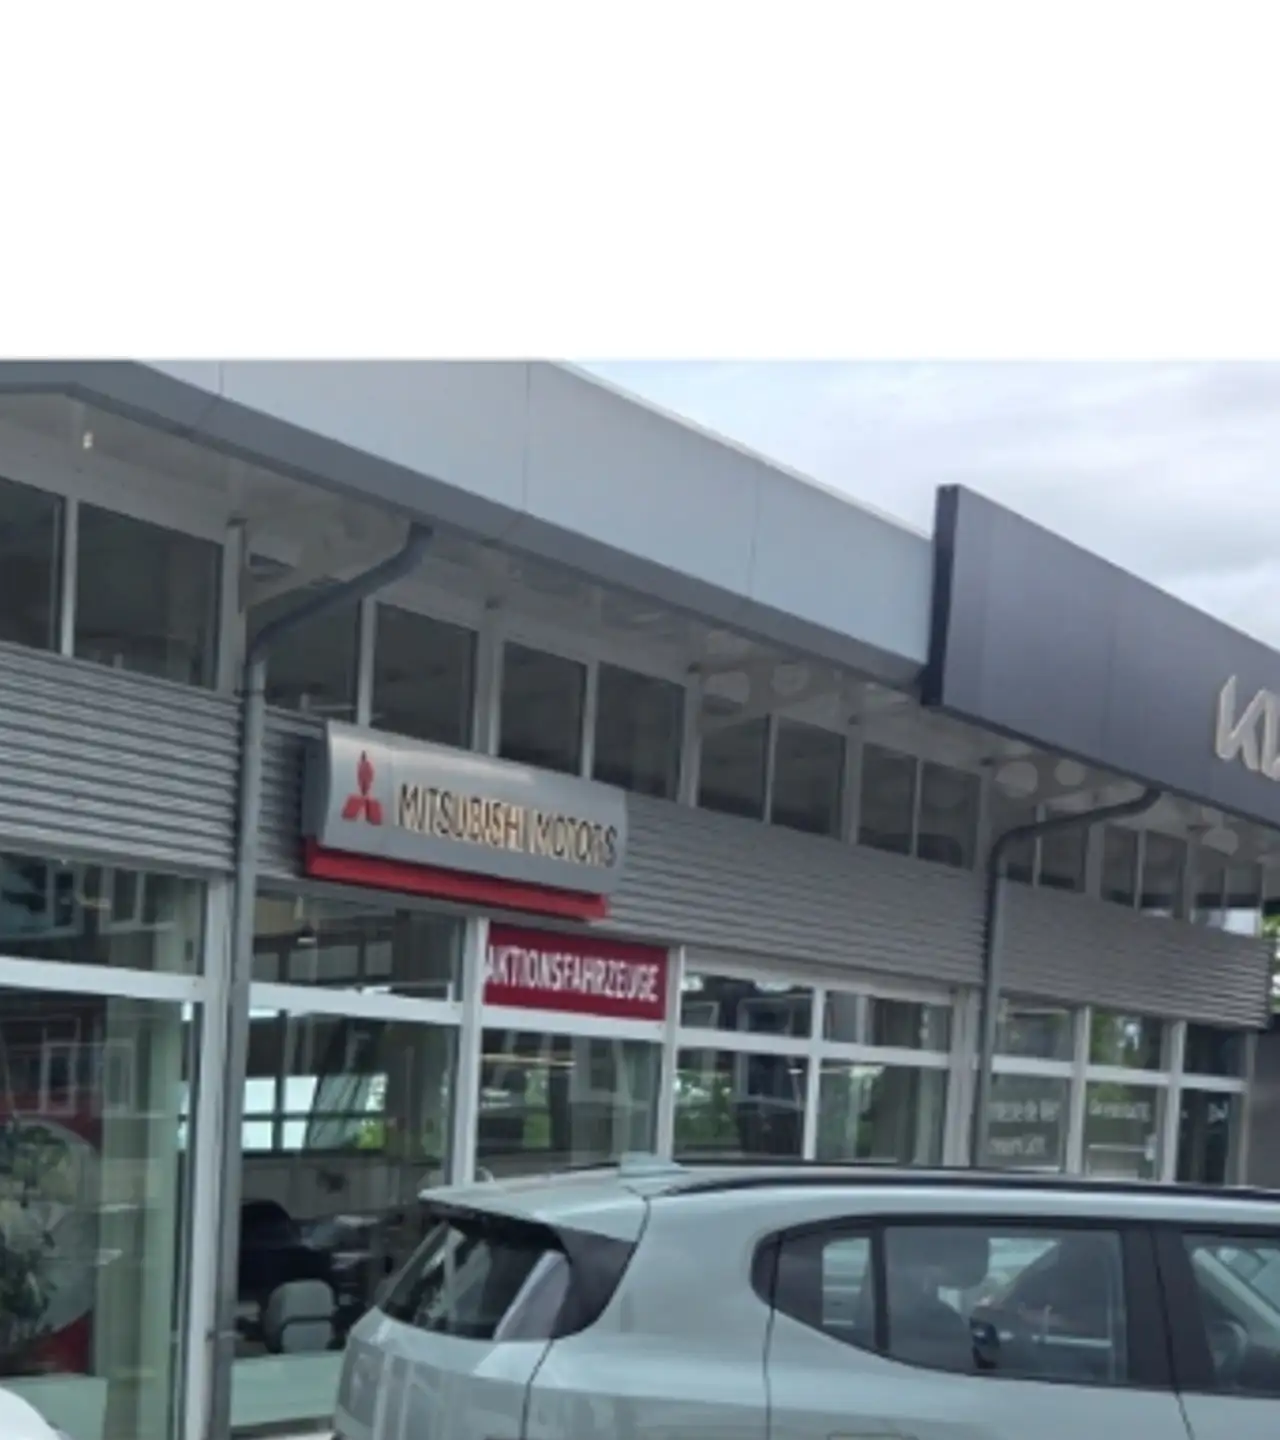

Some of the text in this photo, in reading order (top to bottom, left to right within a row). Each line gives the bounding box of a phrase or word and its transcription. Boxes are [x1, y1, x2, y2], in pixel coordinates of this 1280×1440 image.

[396, 782, 618, 869] MITSUBISHI MOTORS
[483, 944, 660, 1003] AKTIONSFAHRZEUGE
